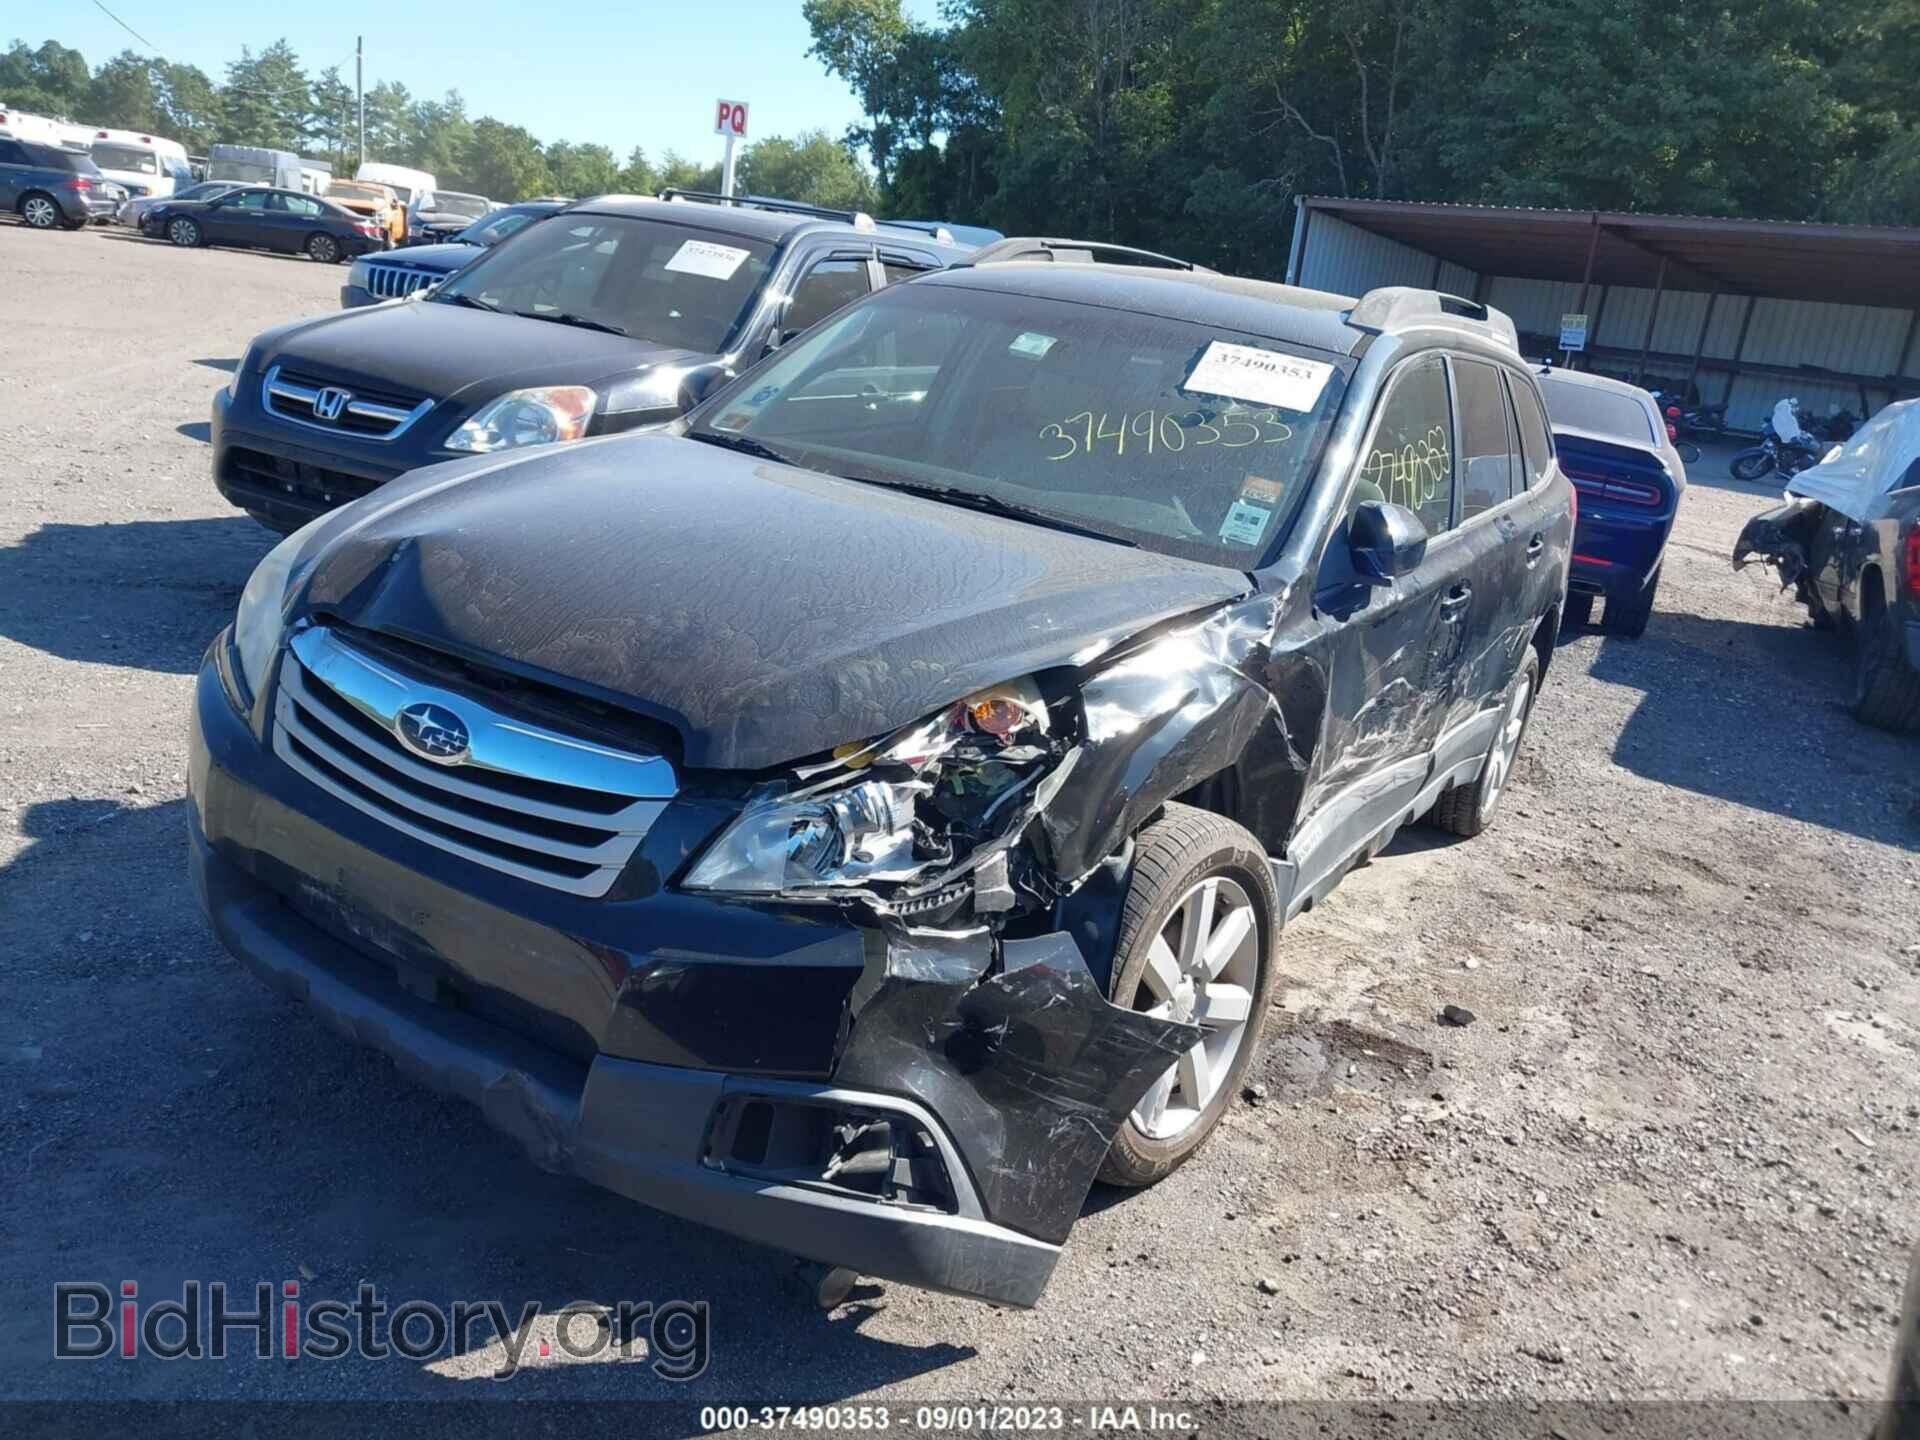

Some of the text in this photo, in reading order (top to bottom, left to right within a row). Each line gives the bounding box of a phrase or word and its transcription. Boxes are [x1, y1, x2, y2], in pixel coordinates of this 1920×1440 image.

[718, 102, 745, 135] PQ
[1215, 352, 1313, 380] 37490353
[1039, 411, 1293, 461] 37490353
